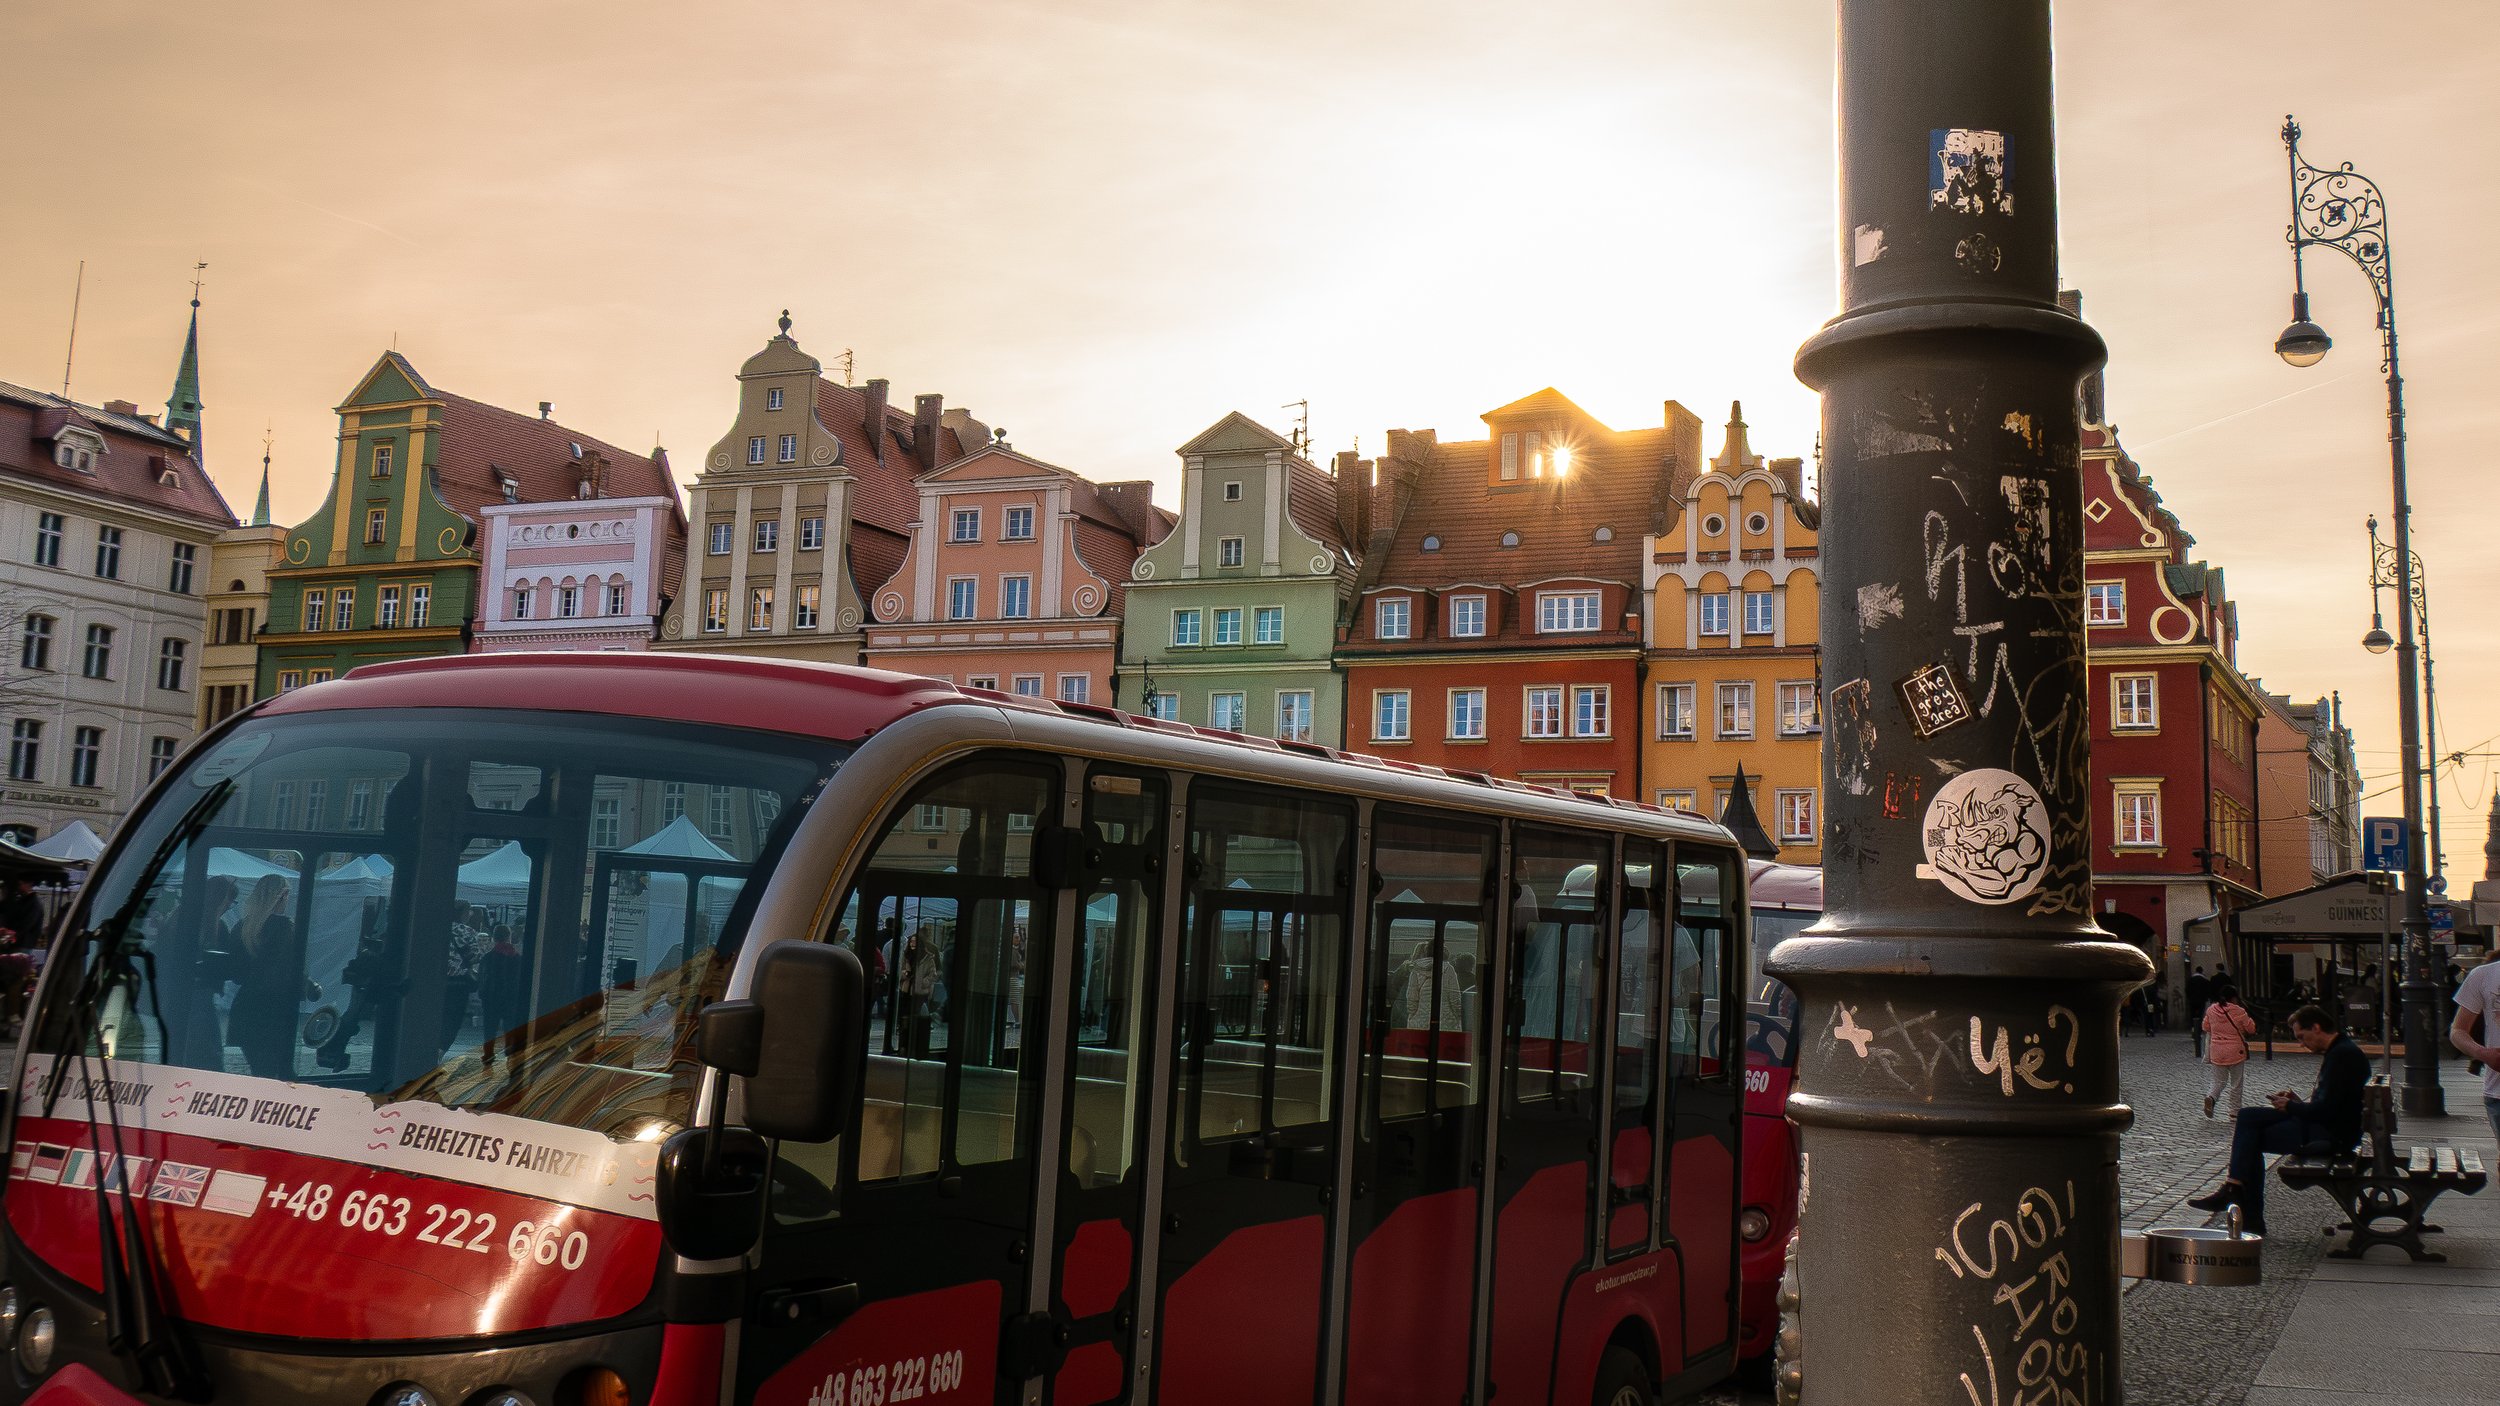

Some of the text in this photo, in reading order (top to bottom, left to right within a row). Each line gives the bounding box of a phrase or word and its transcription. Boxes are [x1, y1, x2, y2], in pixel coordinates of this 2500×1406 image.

[1916, 676, 1944, 696] the
[1918, 689, 1956, 717] grey
[1930, 704, 1961, 725] area
[2374, 822, 2399, 855] P
[2328, 906, 2385, 921] GUINNESS
[186, 1091, 321, 1131] HEATED VEHICLE
[398, 1122, 504, 1163] BEHEIZTES
[267, 1181, 589, 1270] +48 663 222 660
[808, 1350, 963, 1406] +48 663 222 660
